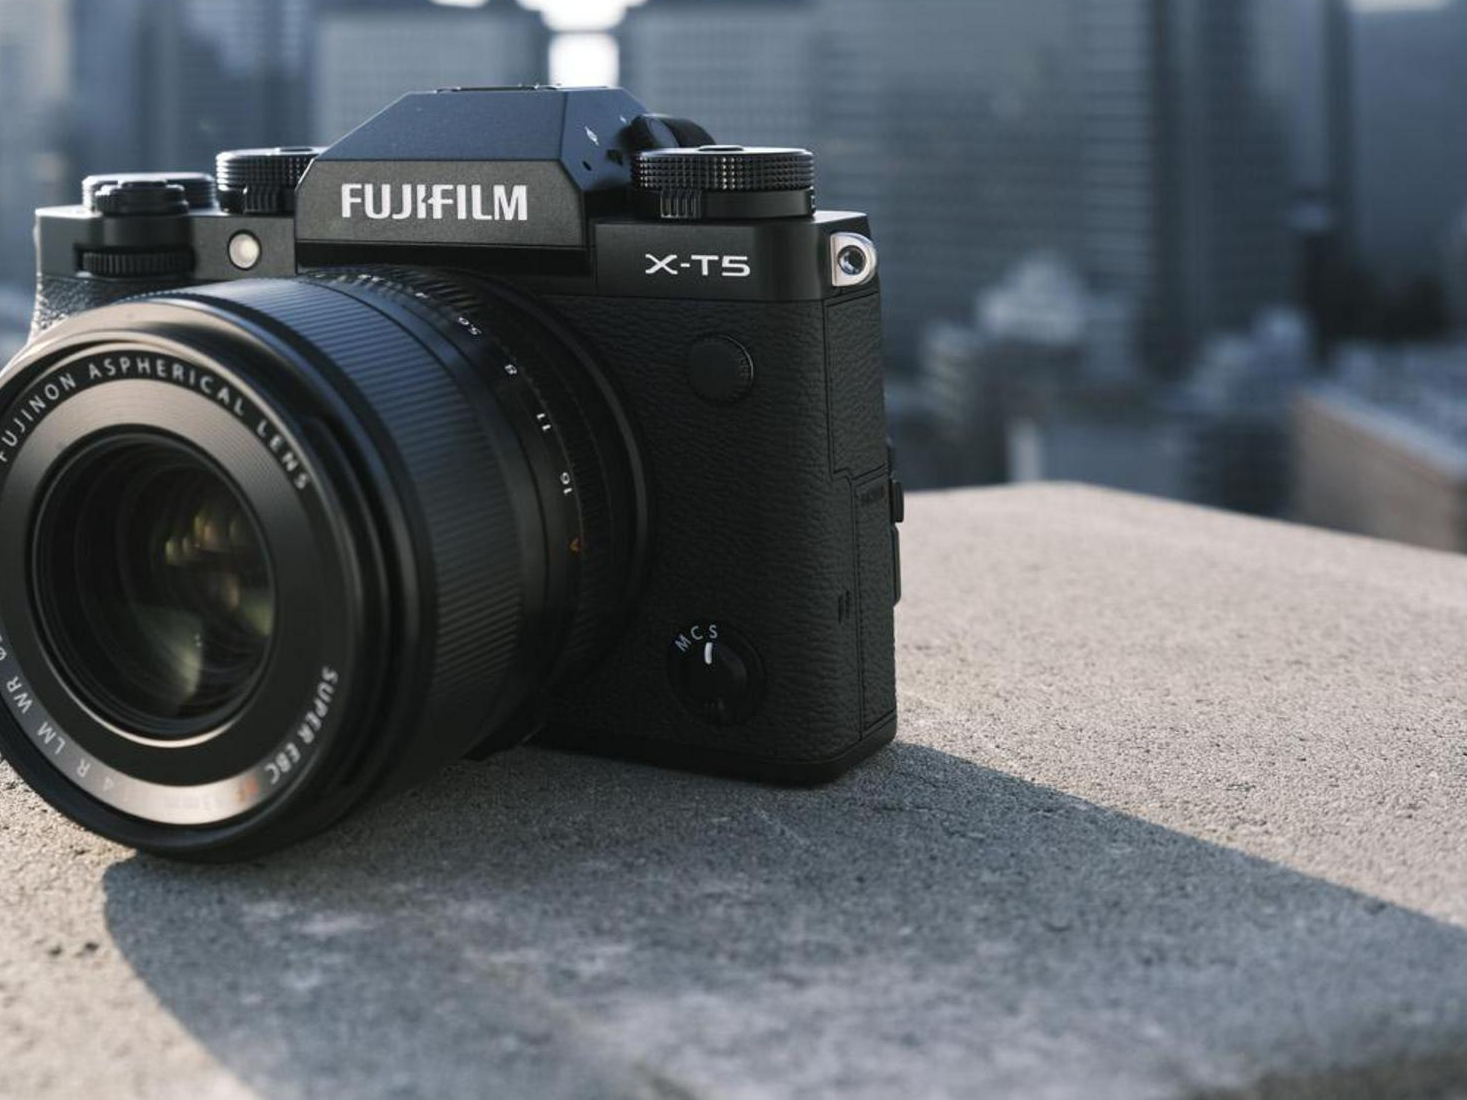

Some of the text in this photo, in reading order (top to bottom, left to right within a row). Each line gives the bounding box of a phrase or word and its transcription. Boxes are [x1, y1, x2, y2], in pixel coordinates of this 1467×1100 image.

[341, 183, 529, 221] FUJIFILM
[645, 254, 751, 277] X-T5
[88, 356, 246, 417] ASPHERICAL
[256, 418, 311, 490] LENS
[6, 676, 33, 714] WR
[297, 665, 339, 745] SUPER
[37, 721, 66, 756] LM
[264, 742, 302, 785] EBC
